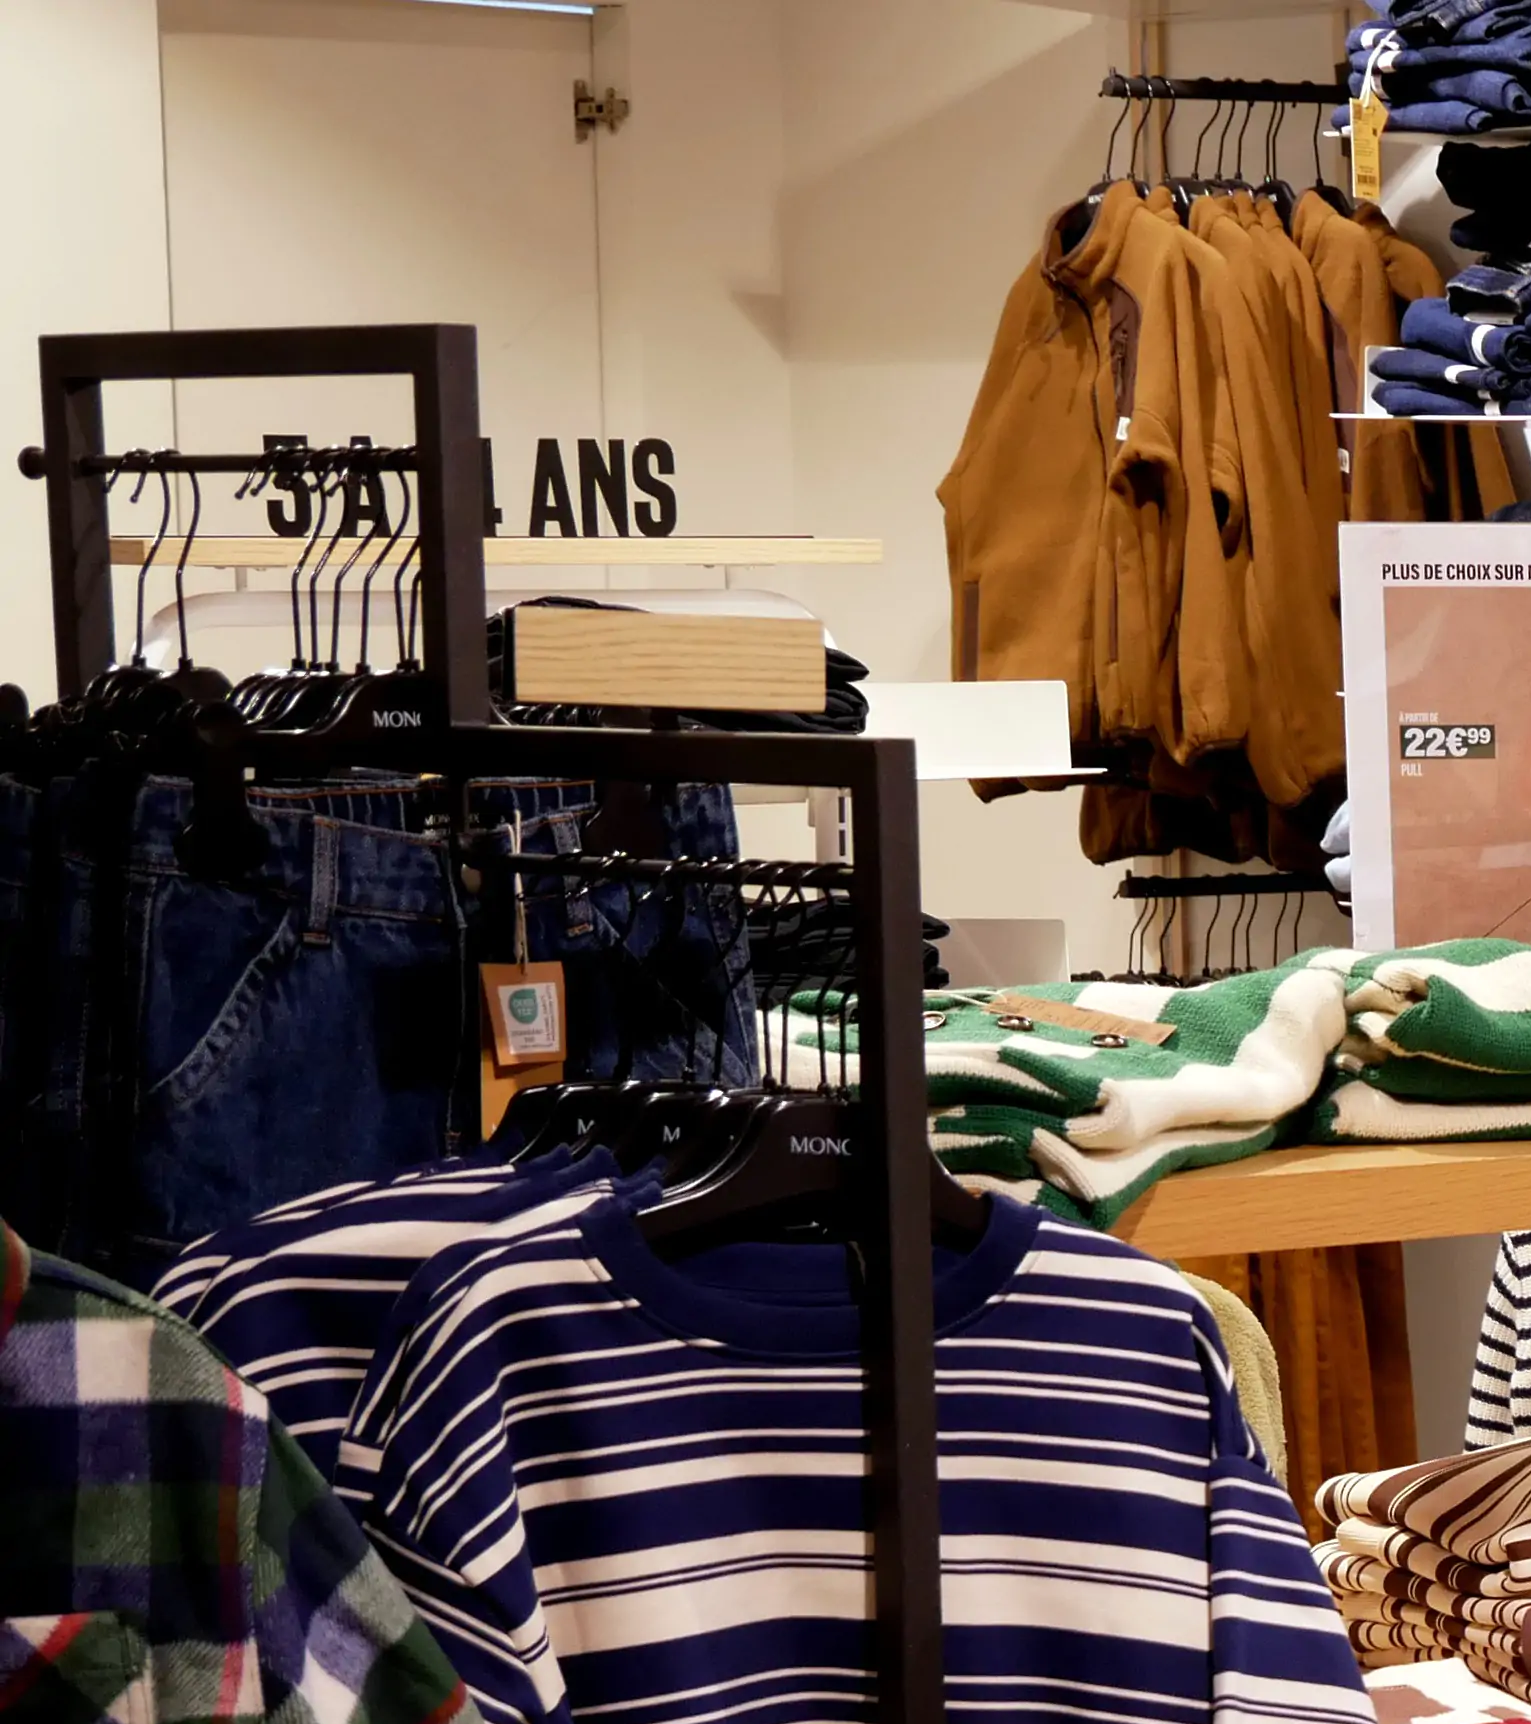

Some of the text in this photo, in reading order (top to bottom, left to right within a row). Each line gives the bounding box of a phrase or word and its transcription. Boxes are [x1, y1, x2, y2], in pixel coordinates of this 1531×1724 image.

[528, 438, 679, 538] ANS
[1381, 563, 1420, 580] PLUS
[1423, 563, 1443, 580] DE
[1446, 563, 1491, 580] CHOIX
[1494, 563, 1524, 580] SUR
[1400, 763, 1423, 776] PULL
